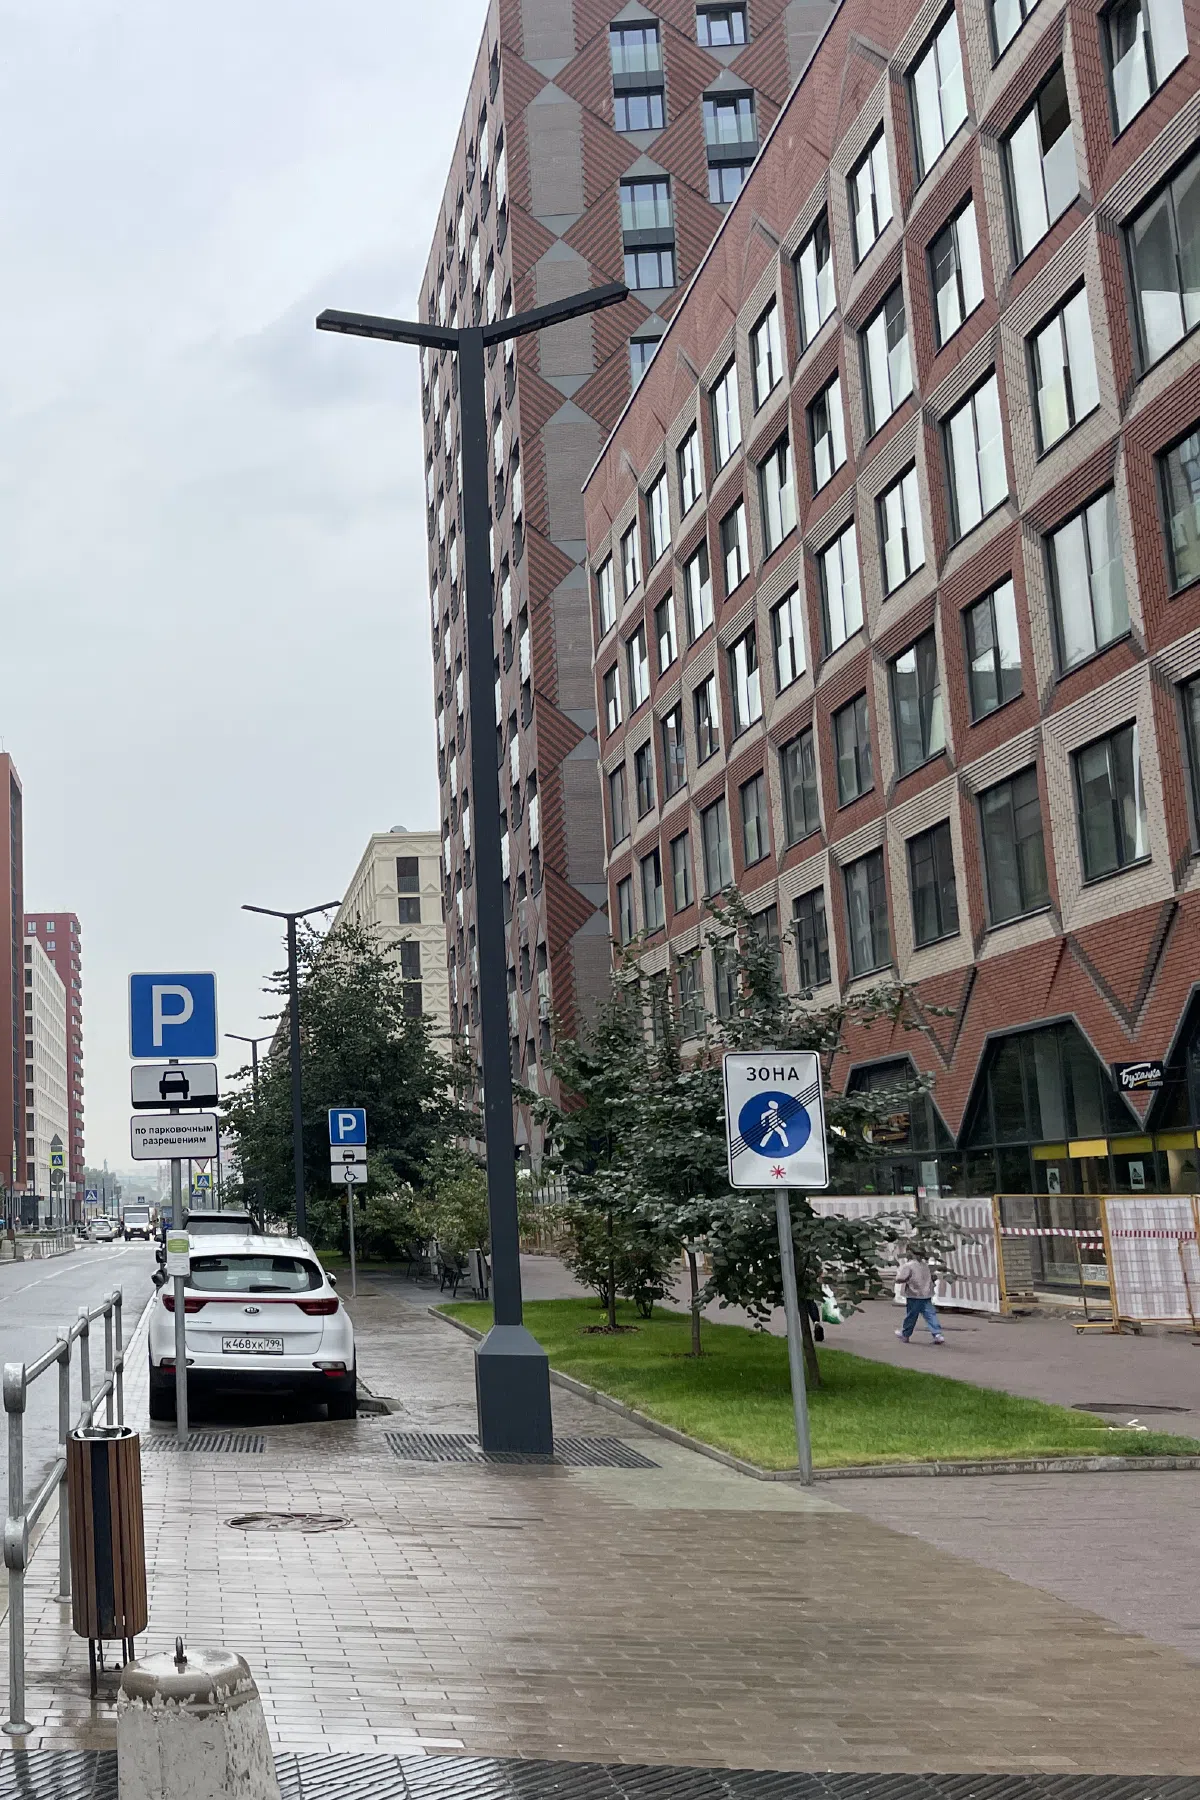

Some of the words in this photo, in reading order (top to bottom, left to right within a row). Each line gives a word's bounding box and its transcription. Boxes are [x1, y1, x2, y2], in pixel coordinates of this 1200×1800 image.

[152, 984, 194, 1047] P
[746, 1066, 800, 1082] ЗОНА
[1119, 1062, 1162, 1089] Буханка
[135, 1127, 147, 1135] по
[148, 1125, 213, 1135] парковочным
[338, 1113, 357, 1140] P
[142, 1136, 207, 1147] разрешениям
[265, 1339, 280, 1348] 799
